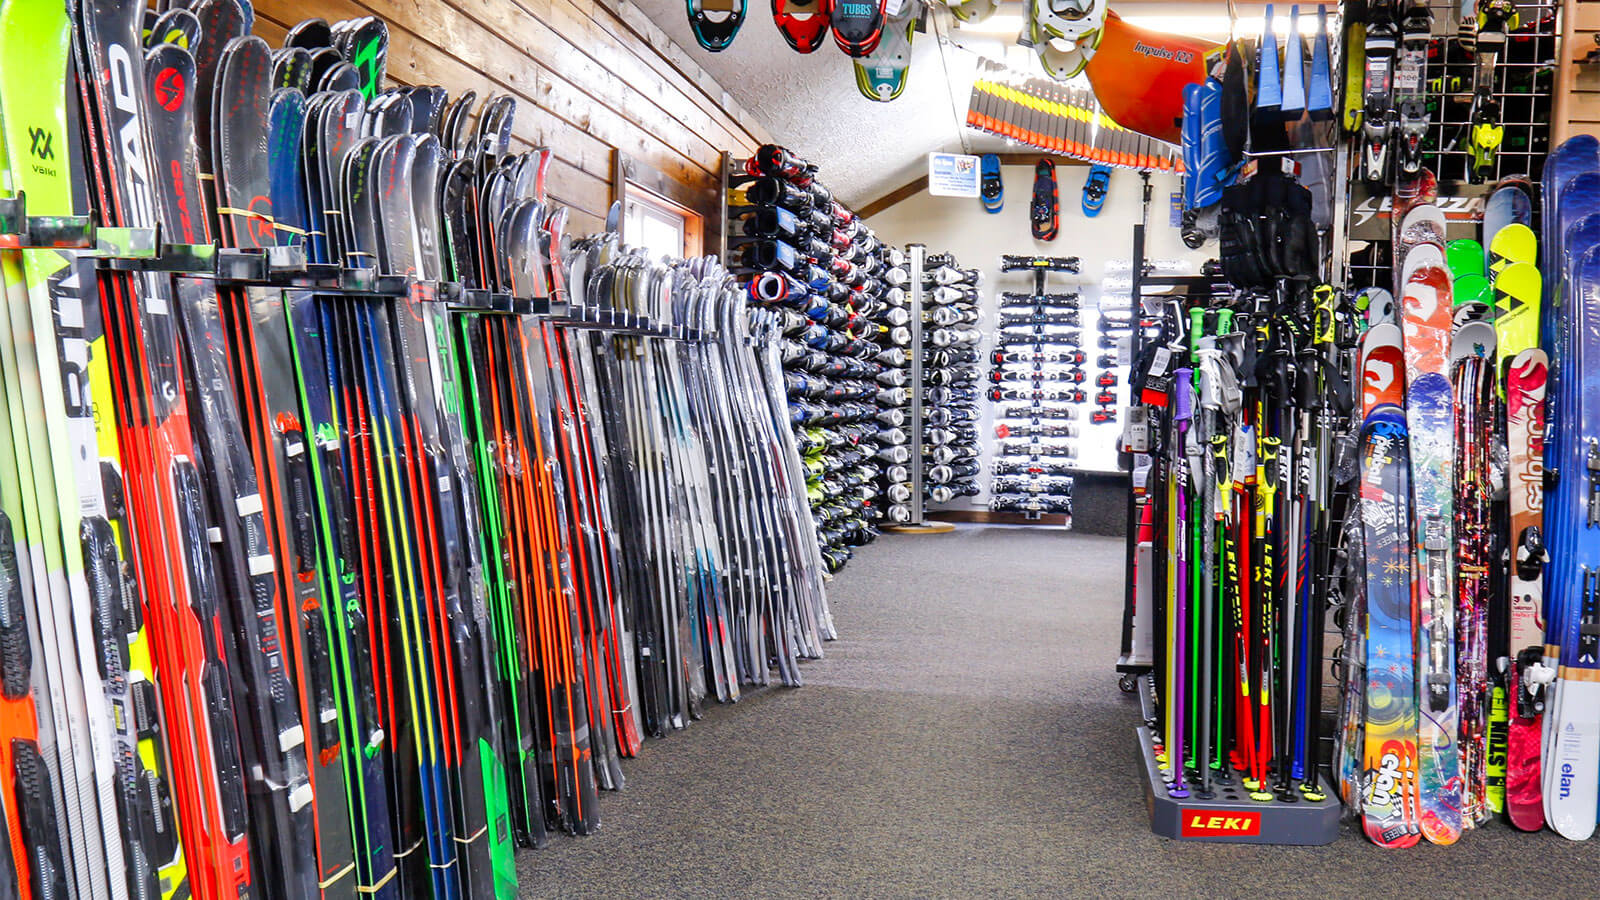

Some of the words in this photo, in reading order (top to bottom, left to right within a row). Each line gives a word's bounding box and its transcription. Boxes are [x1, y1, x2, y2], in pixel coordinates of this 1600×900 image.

[842, 3, 872, 16] TUBBS
[1133, 40, 1174, 59] Impulse
[1180, 457, 1188, 487] LEKI
[1279, 445, 1288, 482] LEKI
[1302, 446, 1310, 484] LEKI
[1367, 434, 1389, 485] pinball
[1225, 539, 1238, 581] LEKI
[1263, 543, 1273, 587] LEKI
[1372, 753, 1404, 806] elan
[1190, 816, 1252, 831] LEKI
